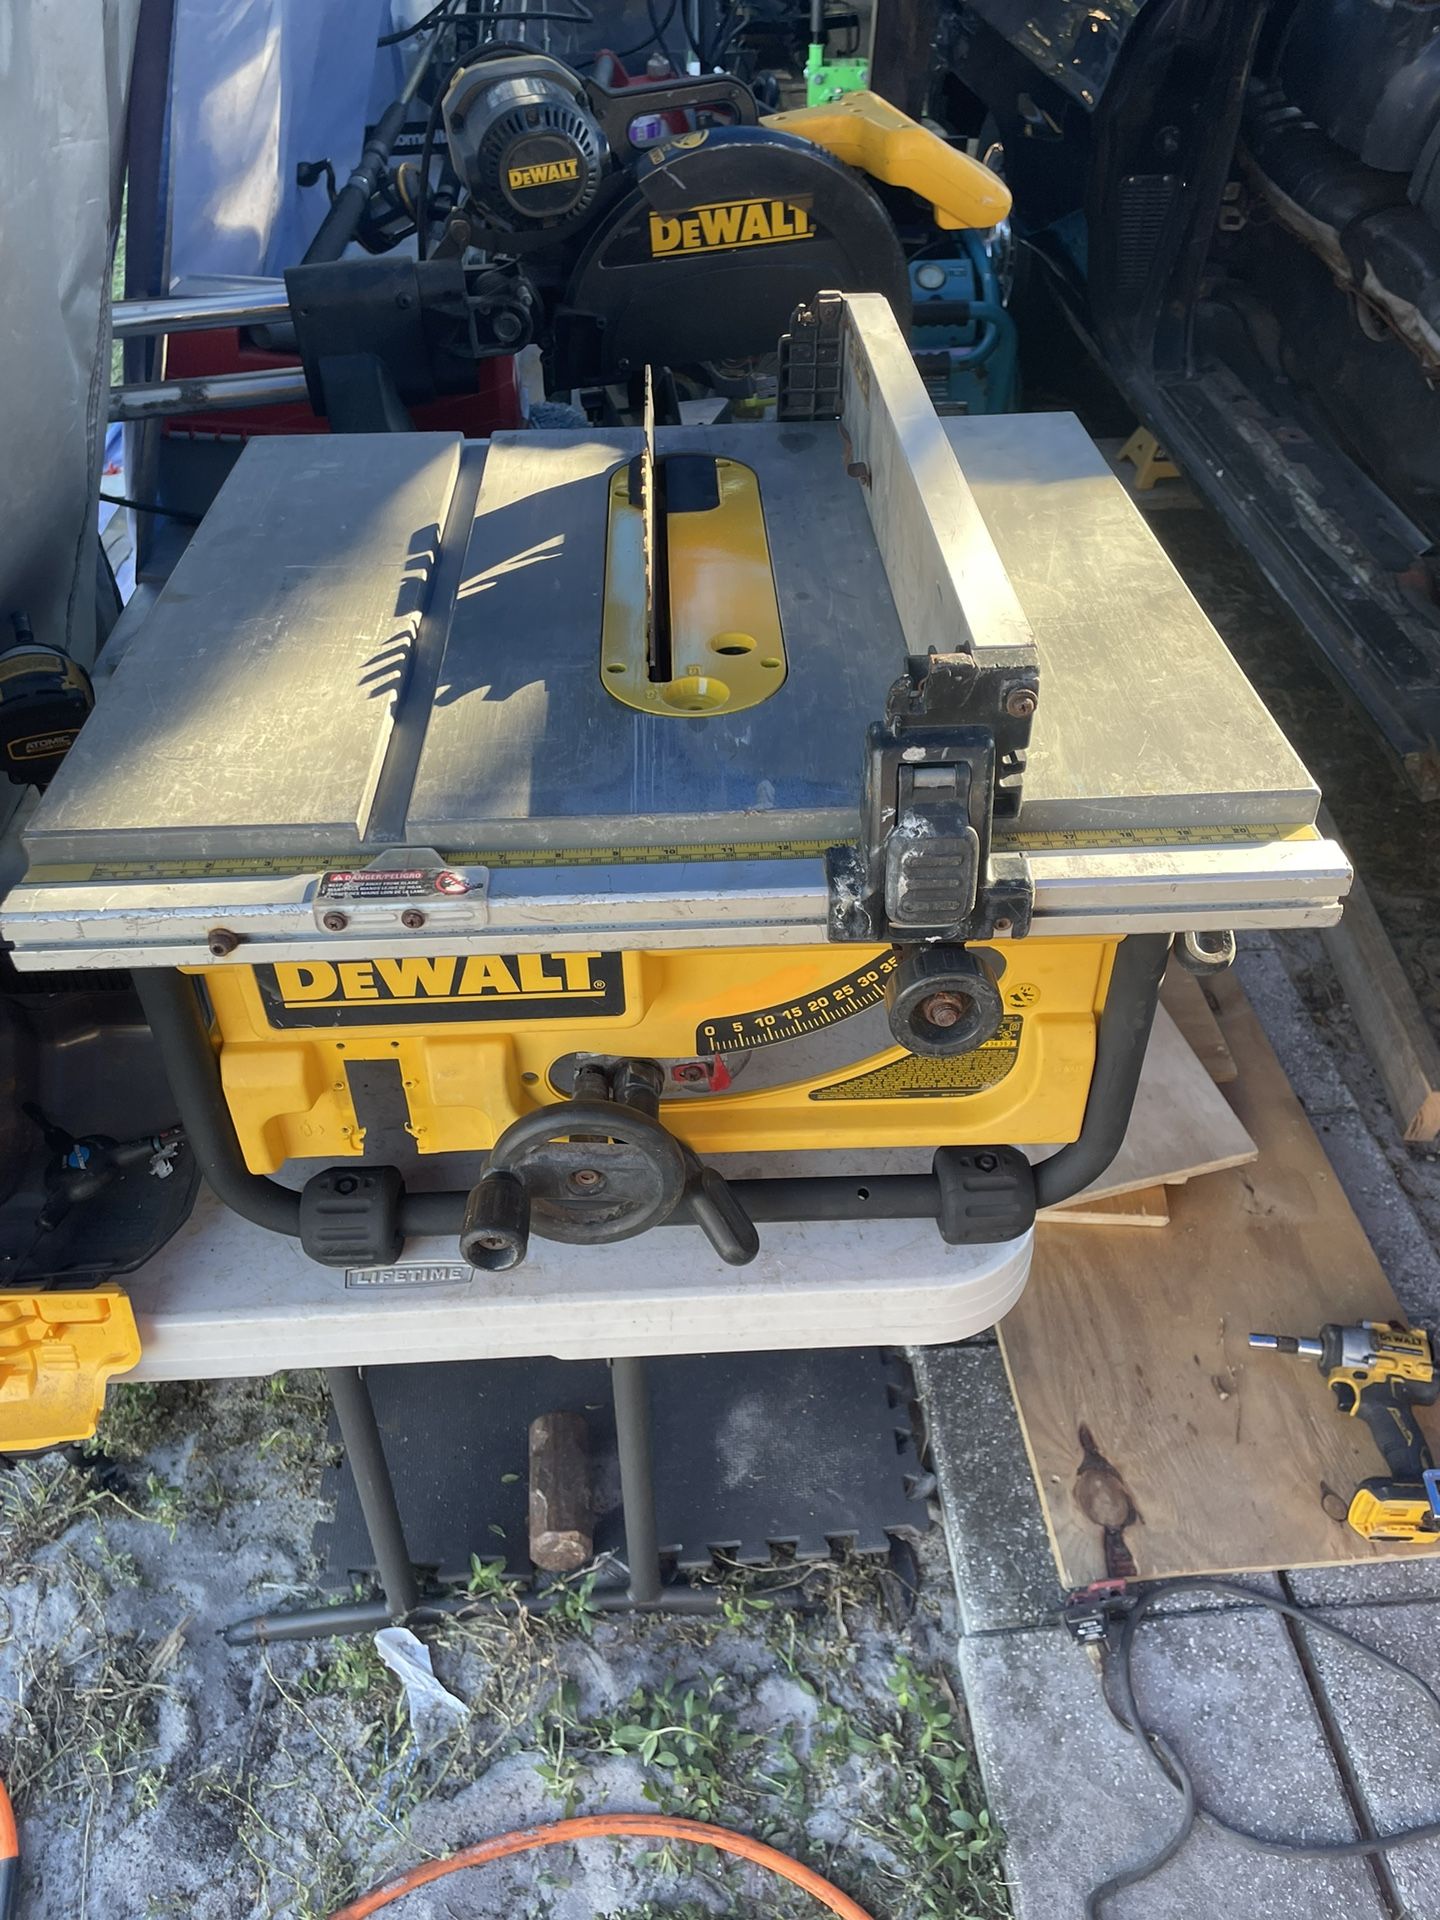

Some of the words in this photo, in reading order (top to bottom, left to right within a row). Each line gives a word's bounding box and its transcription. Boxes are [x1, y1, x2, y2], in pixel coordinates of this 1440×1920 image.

[509, 160, 578, 188] DEWALT
[649, 200, 809, 252] DEWALT
[273, 952, 603, 1001] DEWALT
[704, 1026, 716, 1036] 0
[732, 1021, 744, 1032] 5
[754, 1015, 776, 1028] 10
[782, 1006, 803, 1020] 15
[807, 996, 830, 1012] 20
[832, 984, 855, 1001] 25
[857, 970, 879, 988] 30
[356, 1267, 463, 1285] LIFETIME
